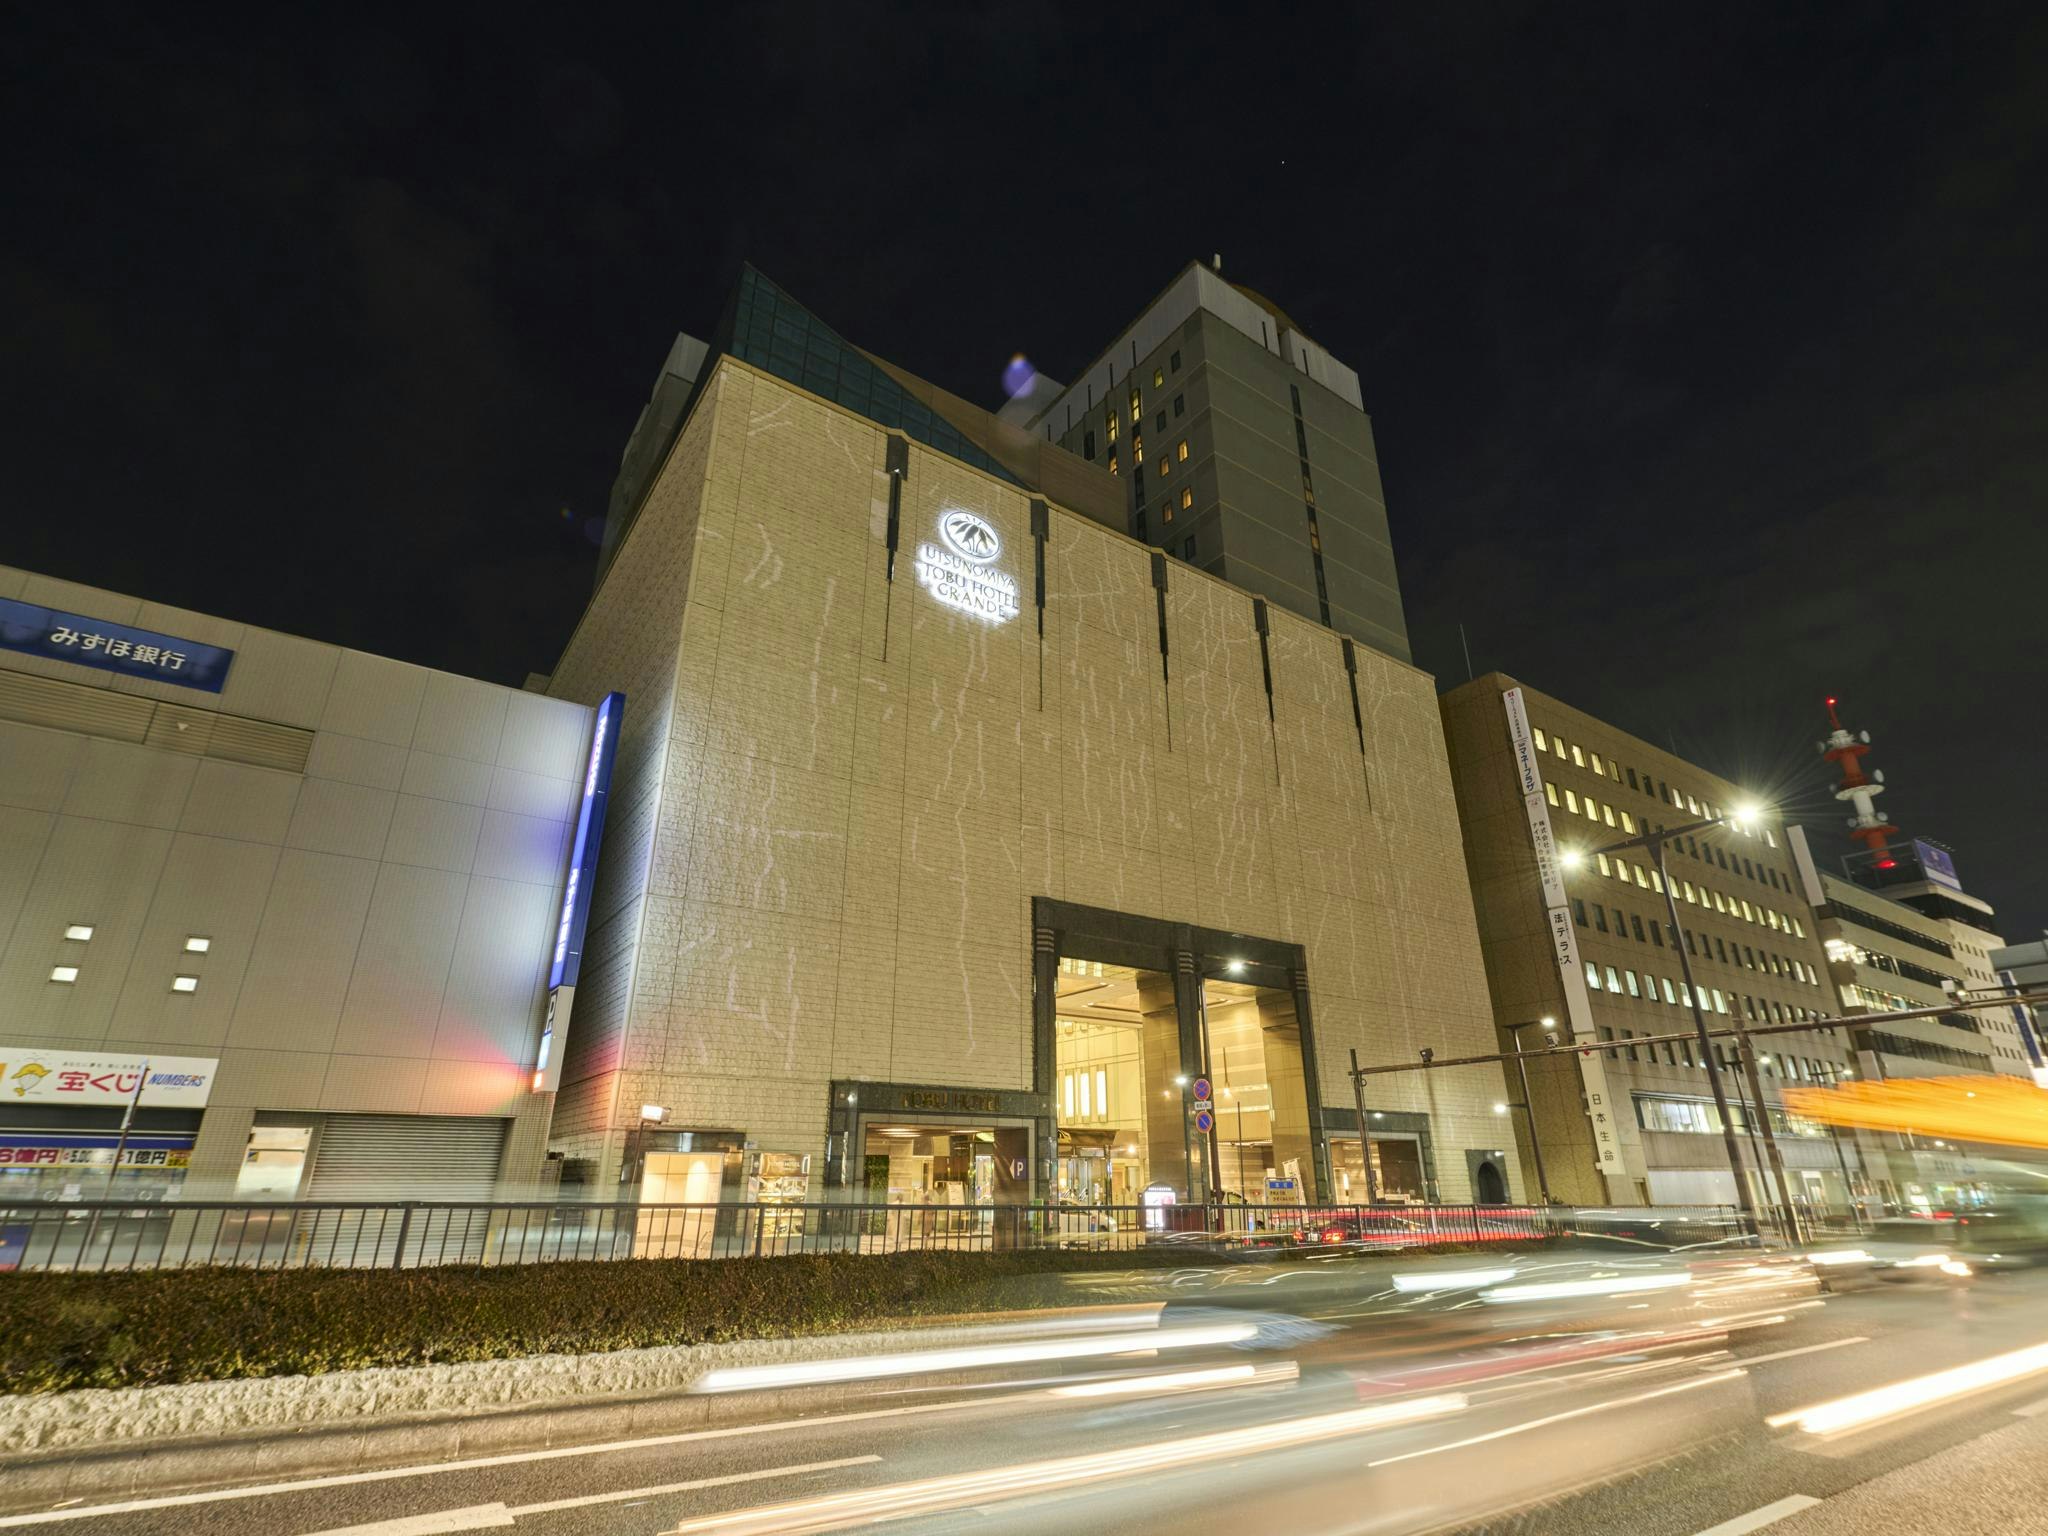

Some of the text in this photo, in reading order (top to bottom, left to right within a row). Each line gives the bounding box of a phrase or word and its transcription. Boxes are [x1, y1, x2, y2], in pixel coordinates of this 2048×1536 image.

[925, 545, 1015, 588] UTSUNOMIYA
[925, 563, 1019, 609] TOBU HOTEL
[937, 583, 1005, 618] GRANDE
[51, 626, 187, 670] みずほ銀行
[1553, 912, 1572, 965] 法テラス
[56, 1071, 140, 1093] 宝くじ
[147, 1074, 206, 1087] NUMBERS
[1592, 1093, 1614, 1161] 日本生命
[1017, 1161, 1024, 1176] P
